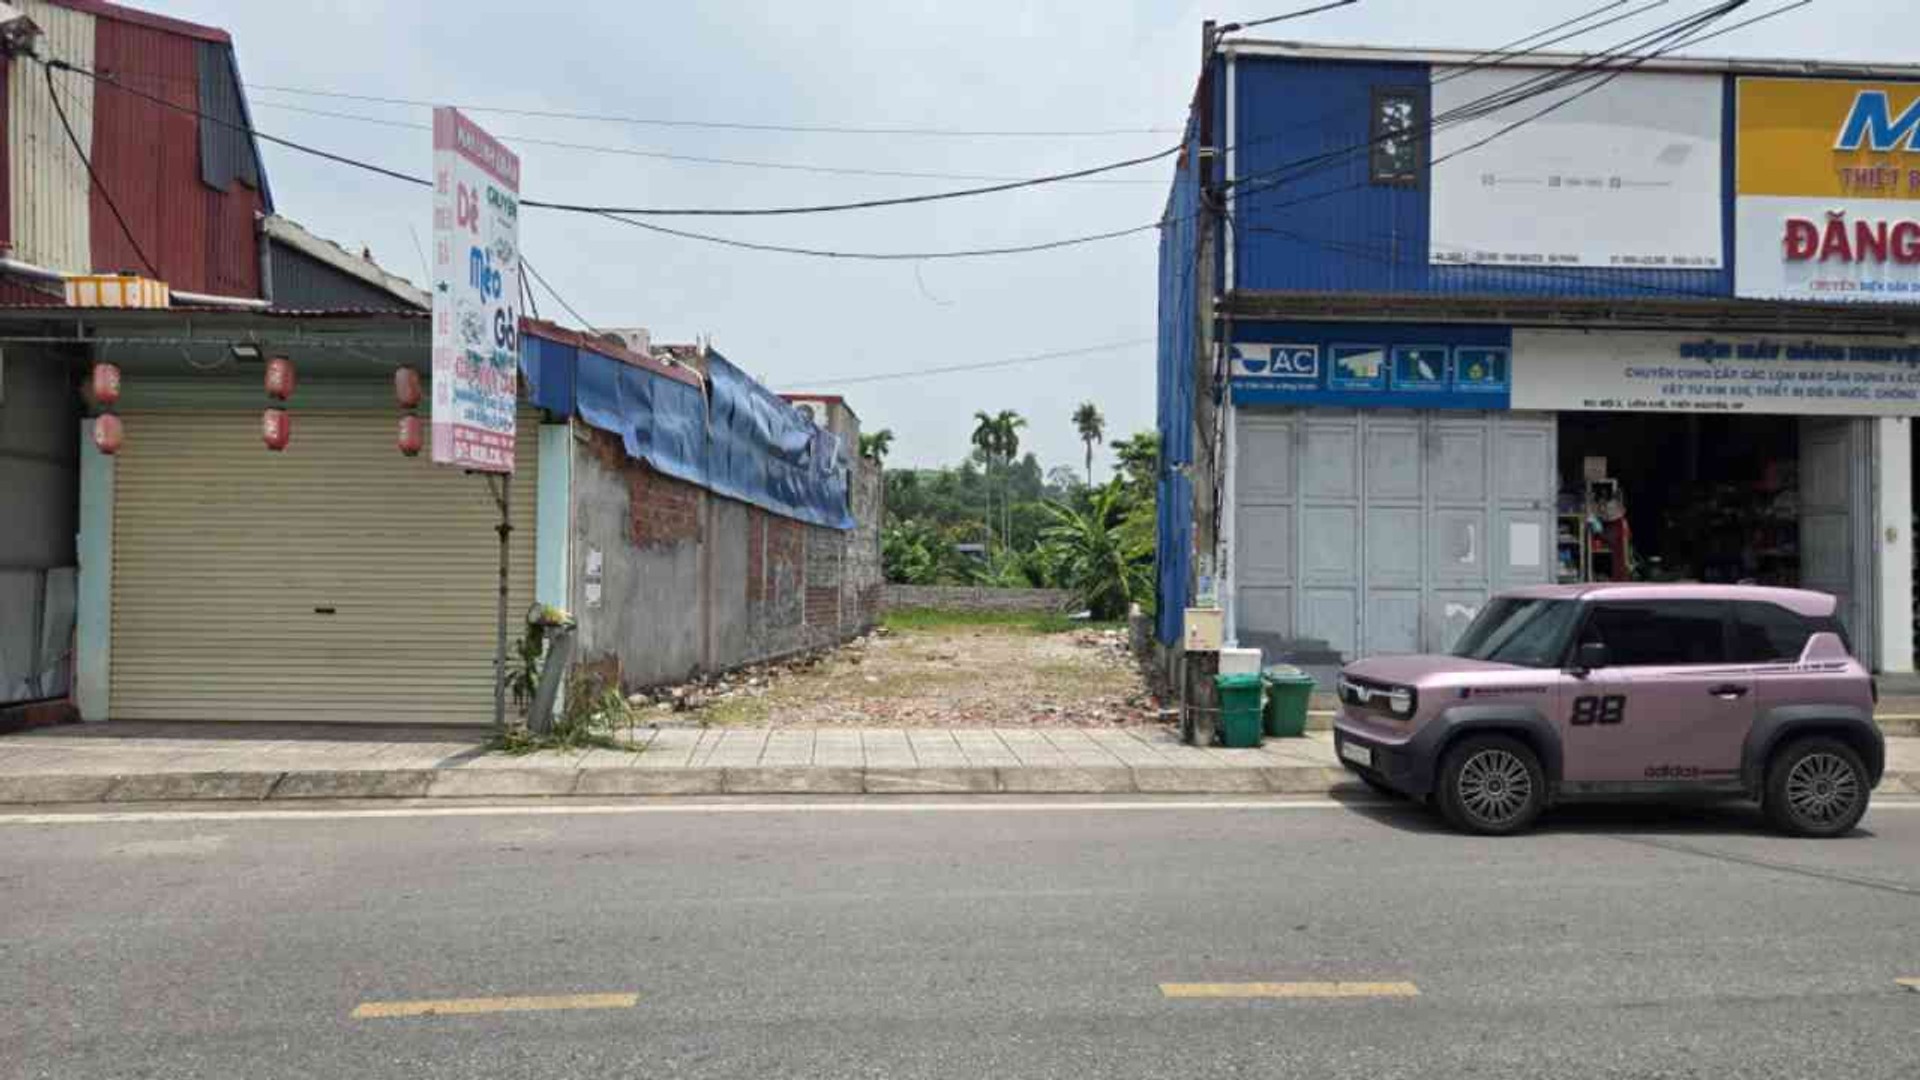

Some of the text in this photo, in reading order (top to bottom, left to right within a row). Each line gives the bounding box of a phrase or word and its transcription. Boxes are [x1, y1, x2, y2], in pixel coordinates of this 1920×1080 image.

[1782, 210, 1920, 264] ĐĂNG
[1272, 350, 1313, 372] AC
[1571, 696, 1626, 725] 88
[1644, 765, 1699, 777] adidas
